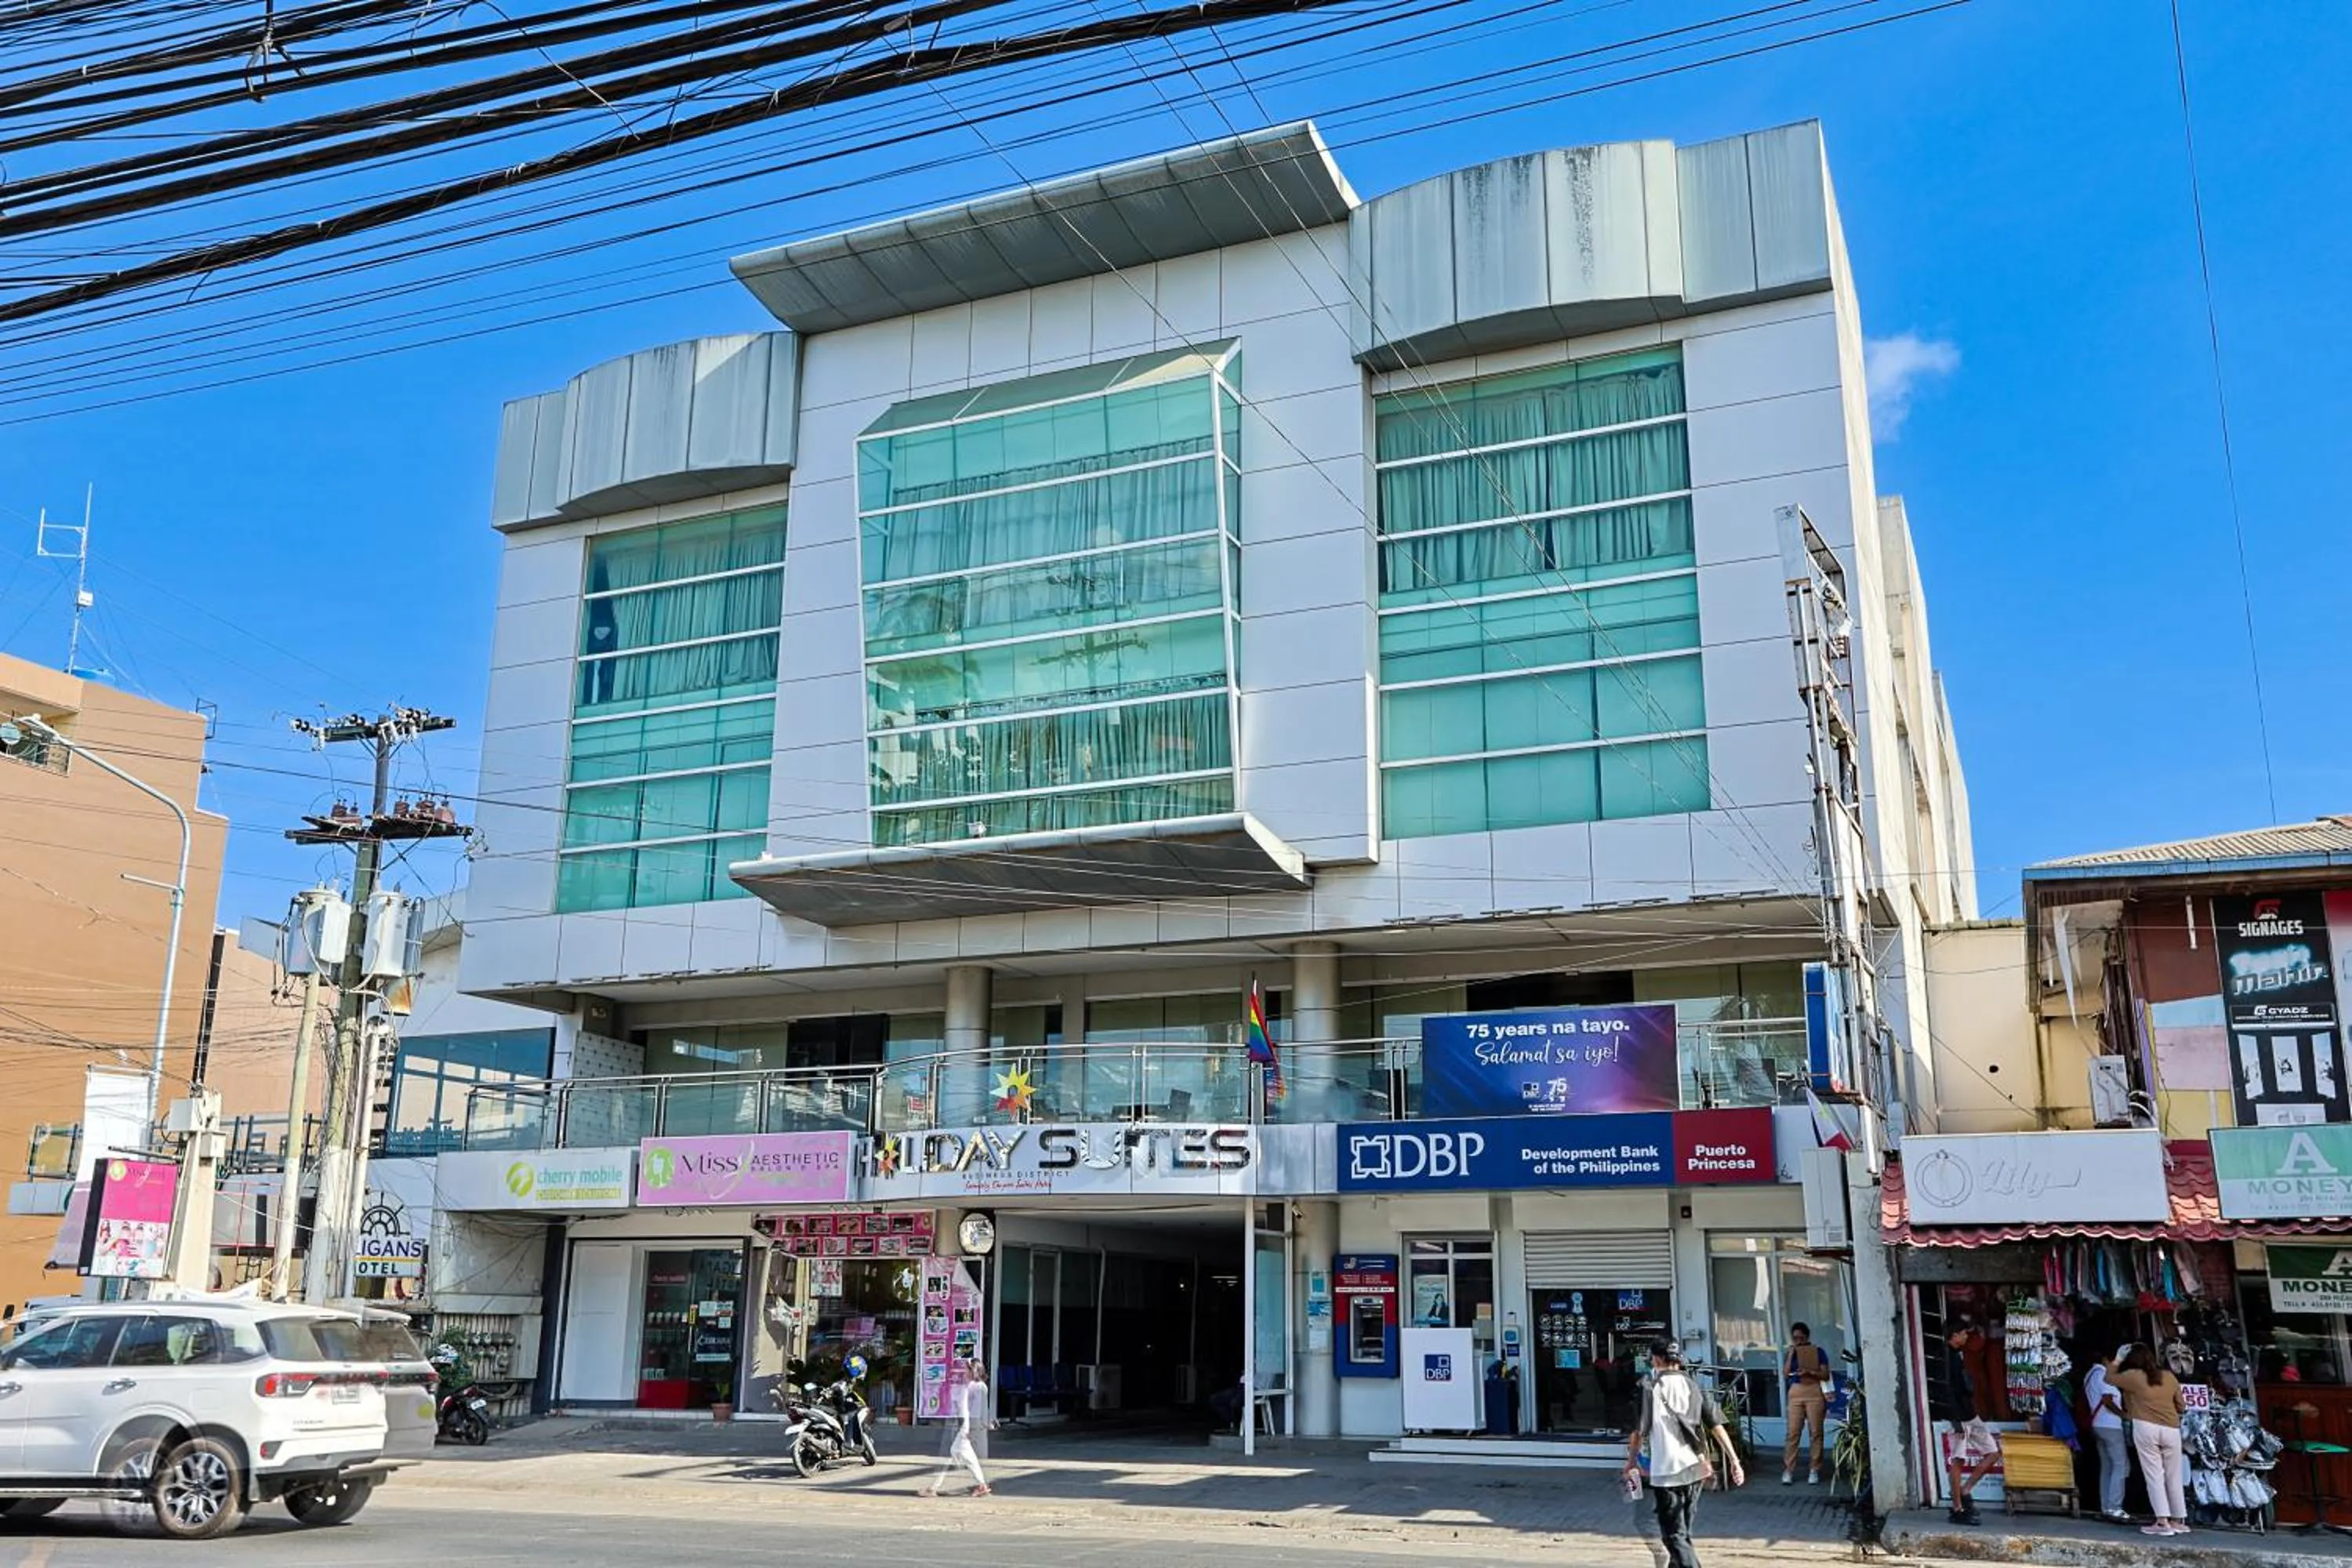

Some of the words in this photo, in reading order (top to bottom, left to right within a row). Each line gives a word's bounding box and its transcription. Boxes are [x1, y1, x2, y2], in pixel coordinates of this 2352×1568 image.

[2238, 920, 2303, 937] SIGNAGES
[1467, 1024, 1490, 1038] 75
[1495, 1024, 1547, 1040] years
[1552, 1022, 1576, 1034] na
[1581, 1019, 1630, 1034] tayo.
[1555, 1047, 1578, 1064] sa
[1584, 1035, 1619, 1067] iyo!
[751, 1152, 839, 1166] AESTHETIC
[855, 1130, 1027, 1178] HLIDAY
[1039, 1129, 1250, 1169] SUITES
[1392, 1132, 1485, 1178] DBP
[1522, 1147, 1617, 1160] Development
[1621, 1145, 1659, 1157] Bank
[1695, 1145, 1746, 1156] Puerto
[2275, 1132, 2338, 1174] A
[682, 1151, 739, 1175] Miss
[1534, 1162, 1548, 1174] of
[1552, 1161, 1575, 1174] the
[1579, 1160, 1661, 1174] Philippines
[1688, 1158, 1755, 1171] Princesa
[537, 1167, 576, 1187] cherry
[579, 1164, 623, 1183] mobile
[2247, 1178, 2352, 1195] MONEY
[357, 1240, 423, 1258] IGANS
[358, 1261, 399, 1274] OTEL
[1426, 1368, 1450, 1379] DBP
[2182, 1386, 2207, 1396] ALE
